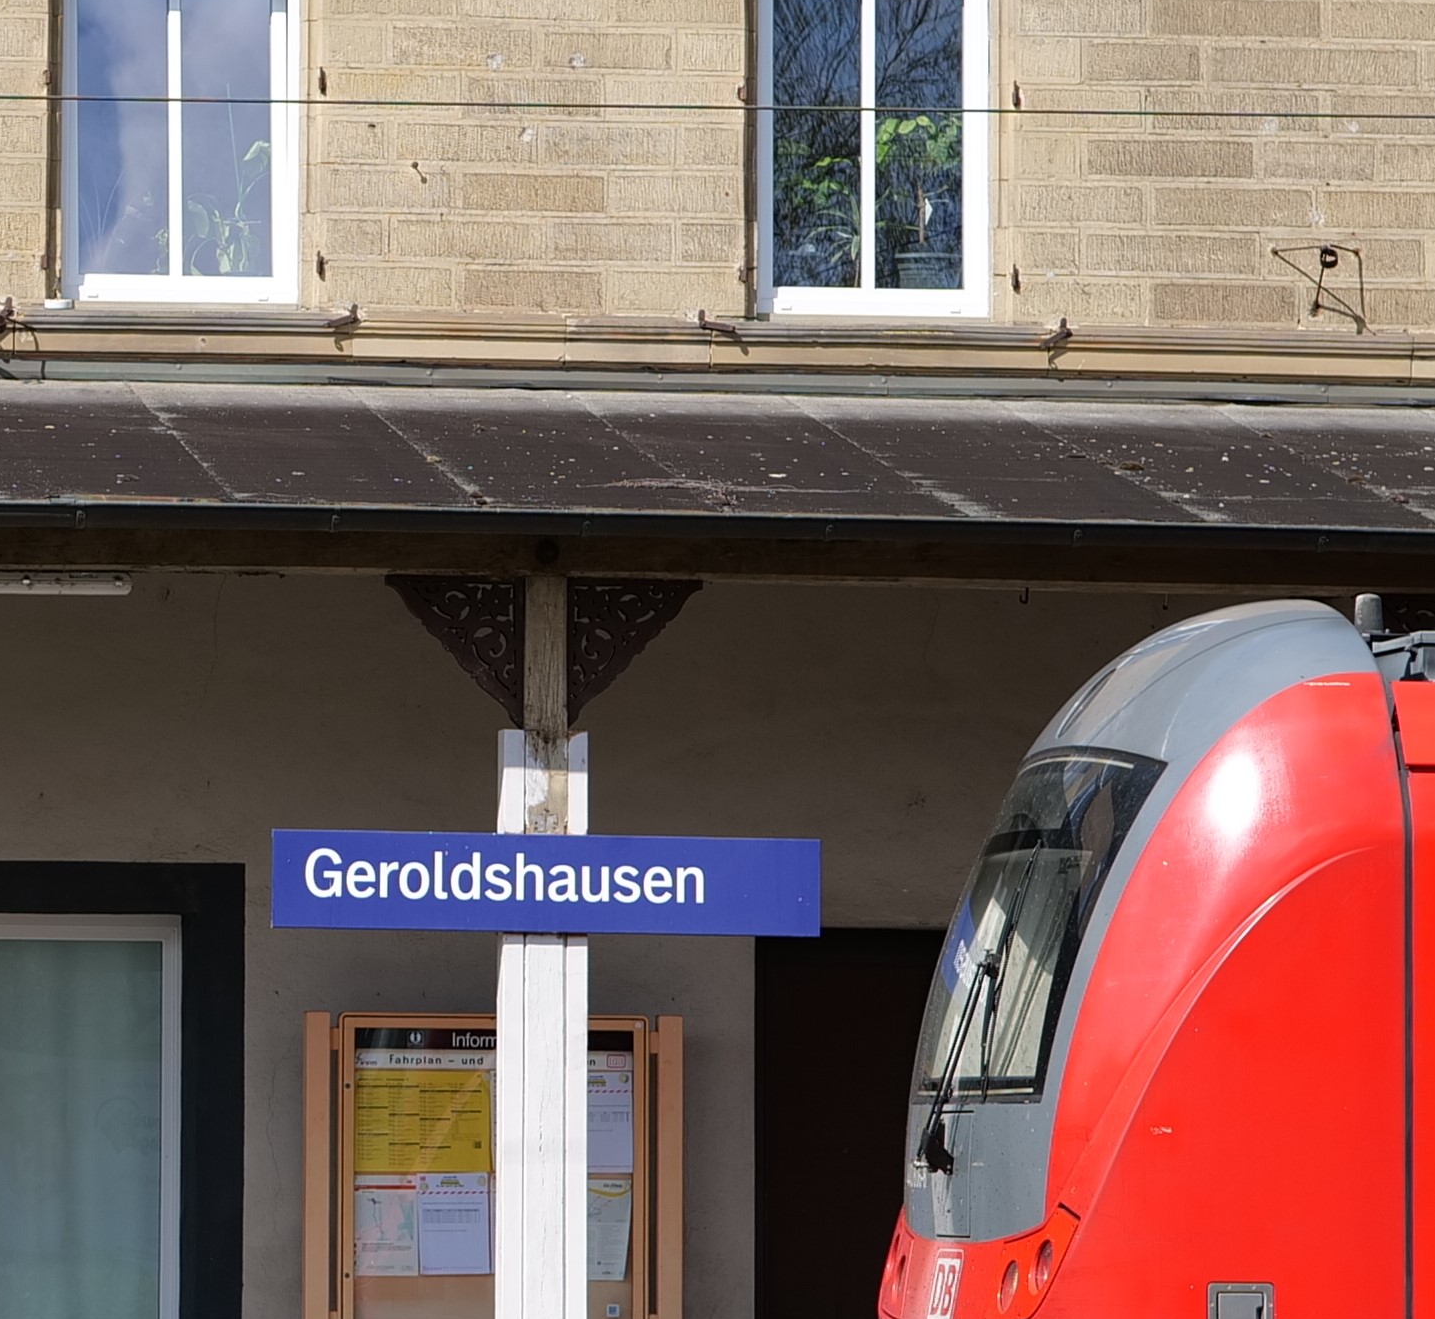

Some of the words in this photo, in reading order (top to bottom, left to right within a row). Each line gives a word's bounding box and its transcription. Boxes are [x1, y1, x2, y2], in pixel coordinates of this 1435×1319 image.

[304, 847, 705, 904] Geroldshausen
[388, 1054, 442, 1067] Fahrplan
[461, 1057, 484, 1066] und
